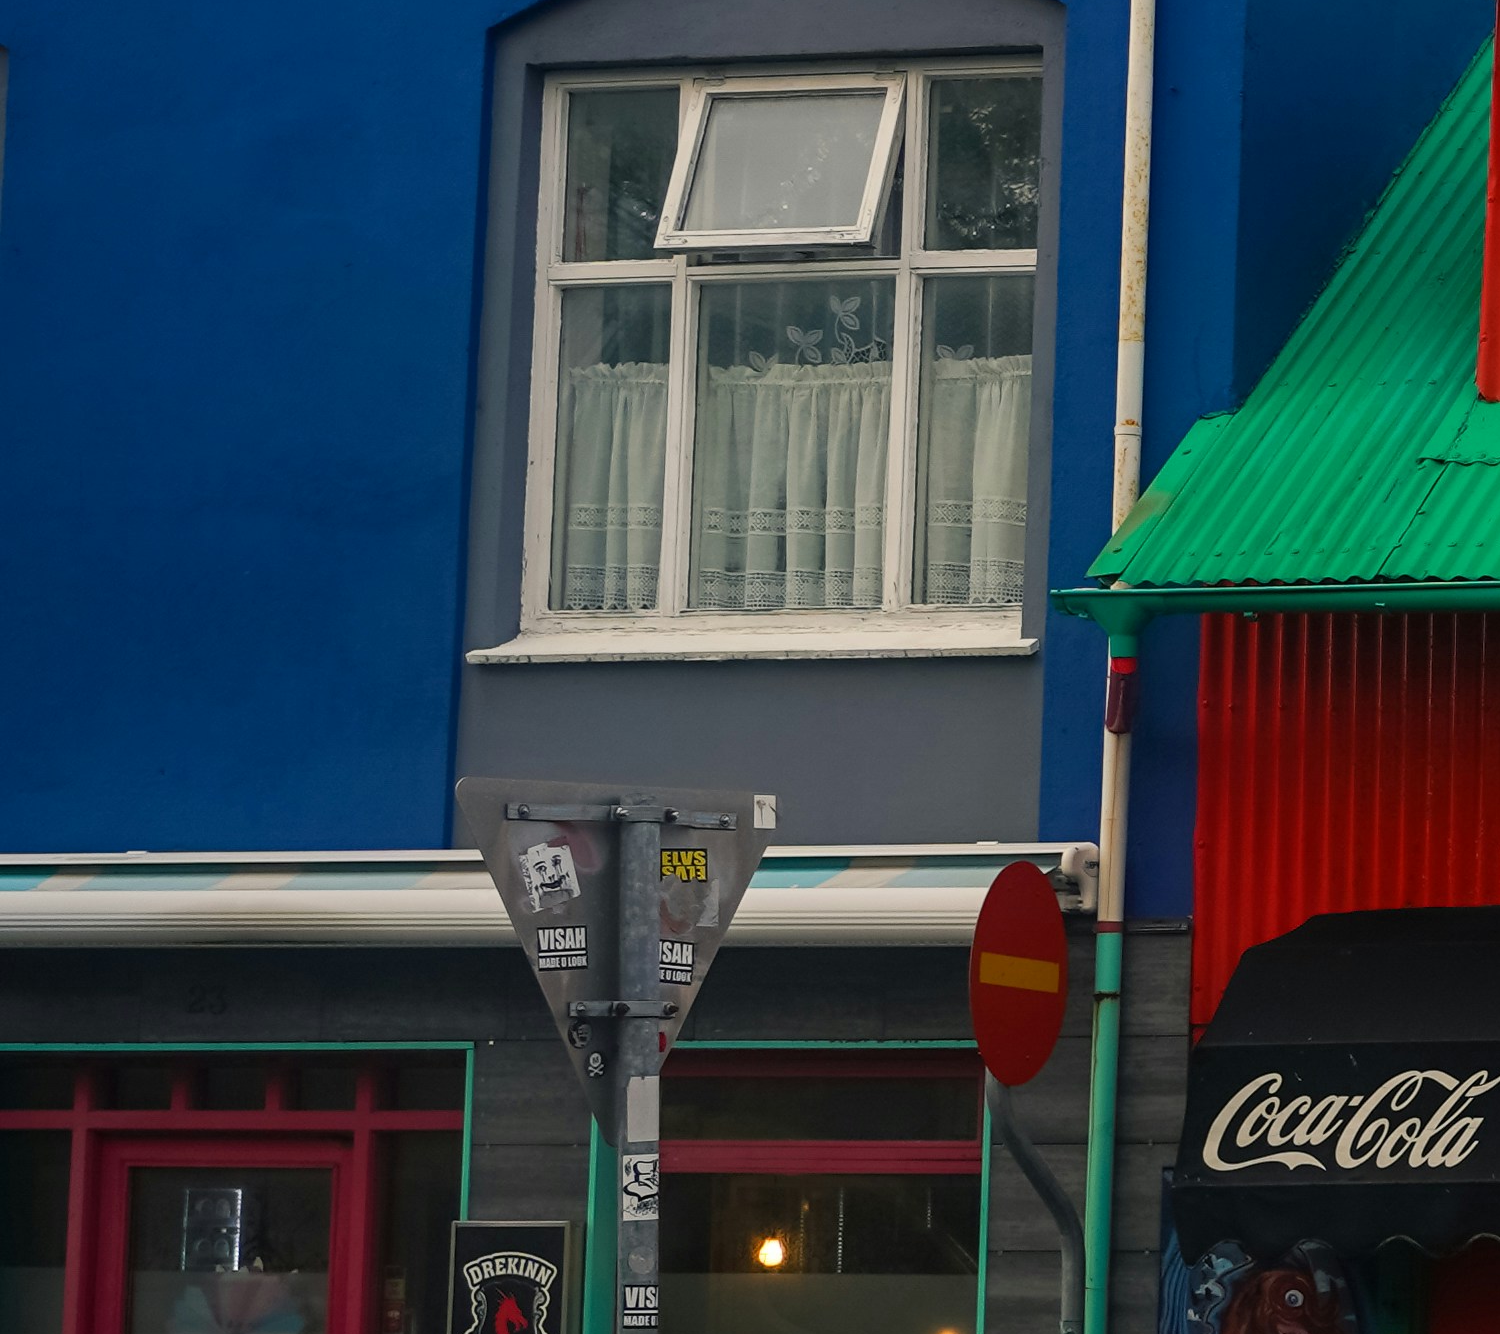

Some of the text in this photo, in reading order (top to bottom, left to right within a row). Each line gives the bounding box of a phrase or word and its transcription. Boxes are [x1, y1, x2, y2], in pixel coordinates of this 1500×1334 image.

[538, 927, 586, 951] VISAH
[659, 941, 692, 965] ISAH
[468, 1257, 552, 1285] DREKINN
[624, 1286, 659, 1308] VIS
[623, 1315, 649, 1326] MADE
